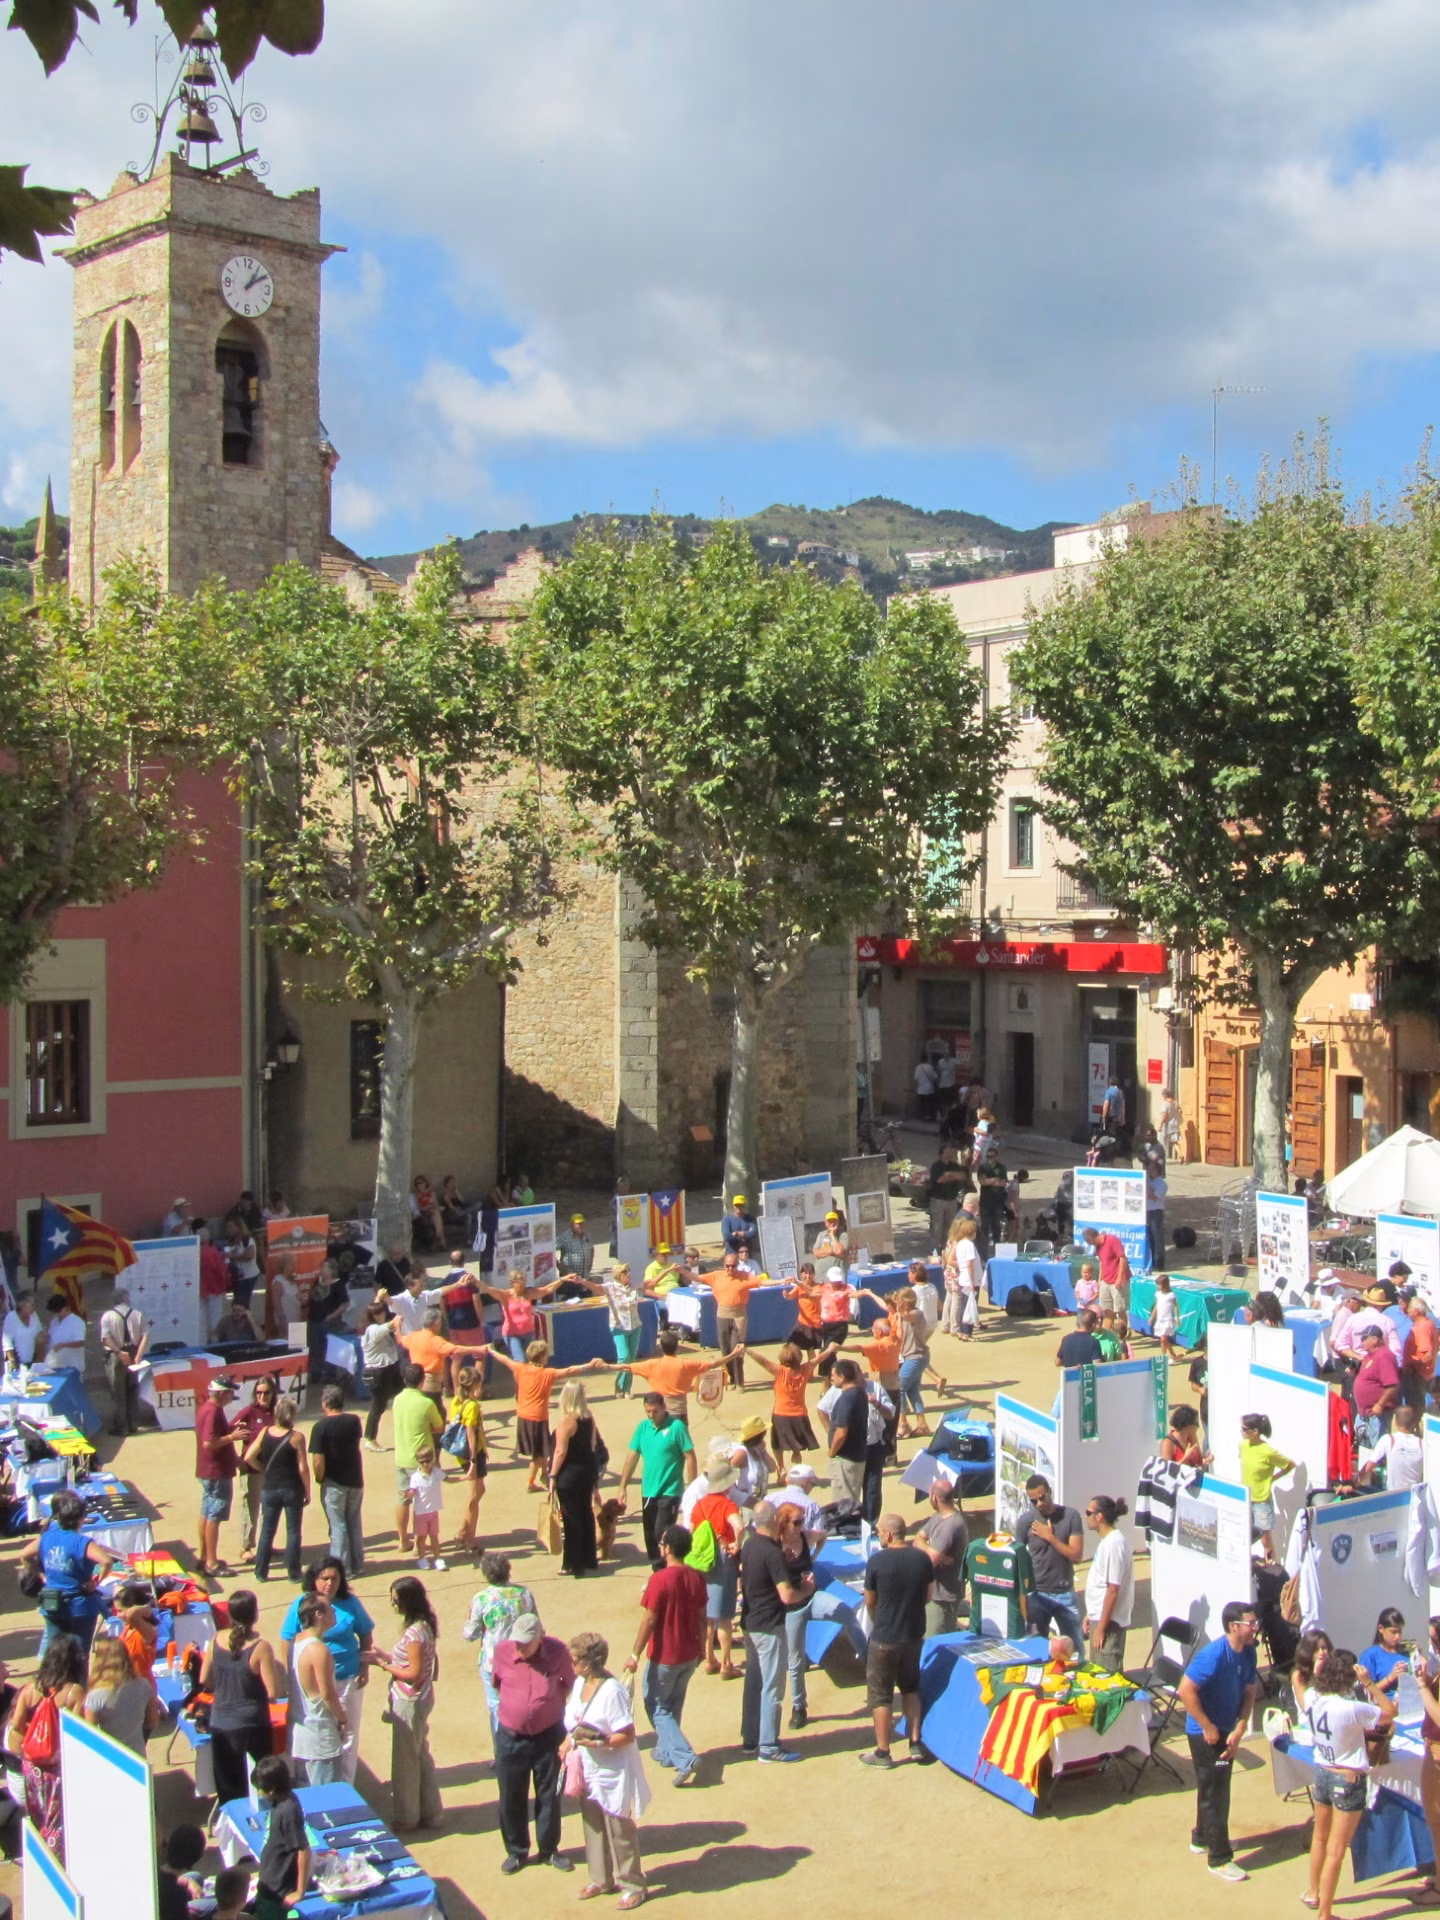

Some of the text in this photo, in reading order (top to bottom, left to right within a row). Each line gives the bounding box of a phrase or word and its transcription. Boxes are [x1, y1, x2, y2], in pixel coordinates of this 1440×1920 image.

[243, 258, 254, 270] 12
[225, 276, 231, 288] 9
[264, 284, 271, 296] 3
[244, 303, 251, 315] 6
[991, 947, 1046, 965] Santander
[1225, 1020, 1246, 1036] forn
[1099, 1227, 1146, 1242] Classique
[1083, 1364, 1093, 1405] ELLA
[1142, 1456, 1169, 1486] 22
[1306, 1706, 1332, 1740] 14
